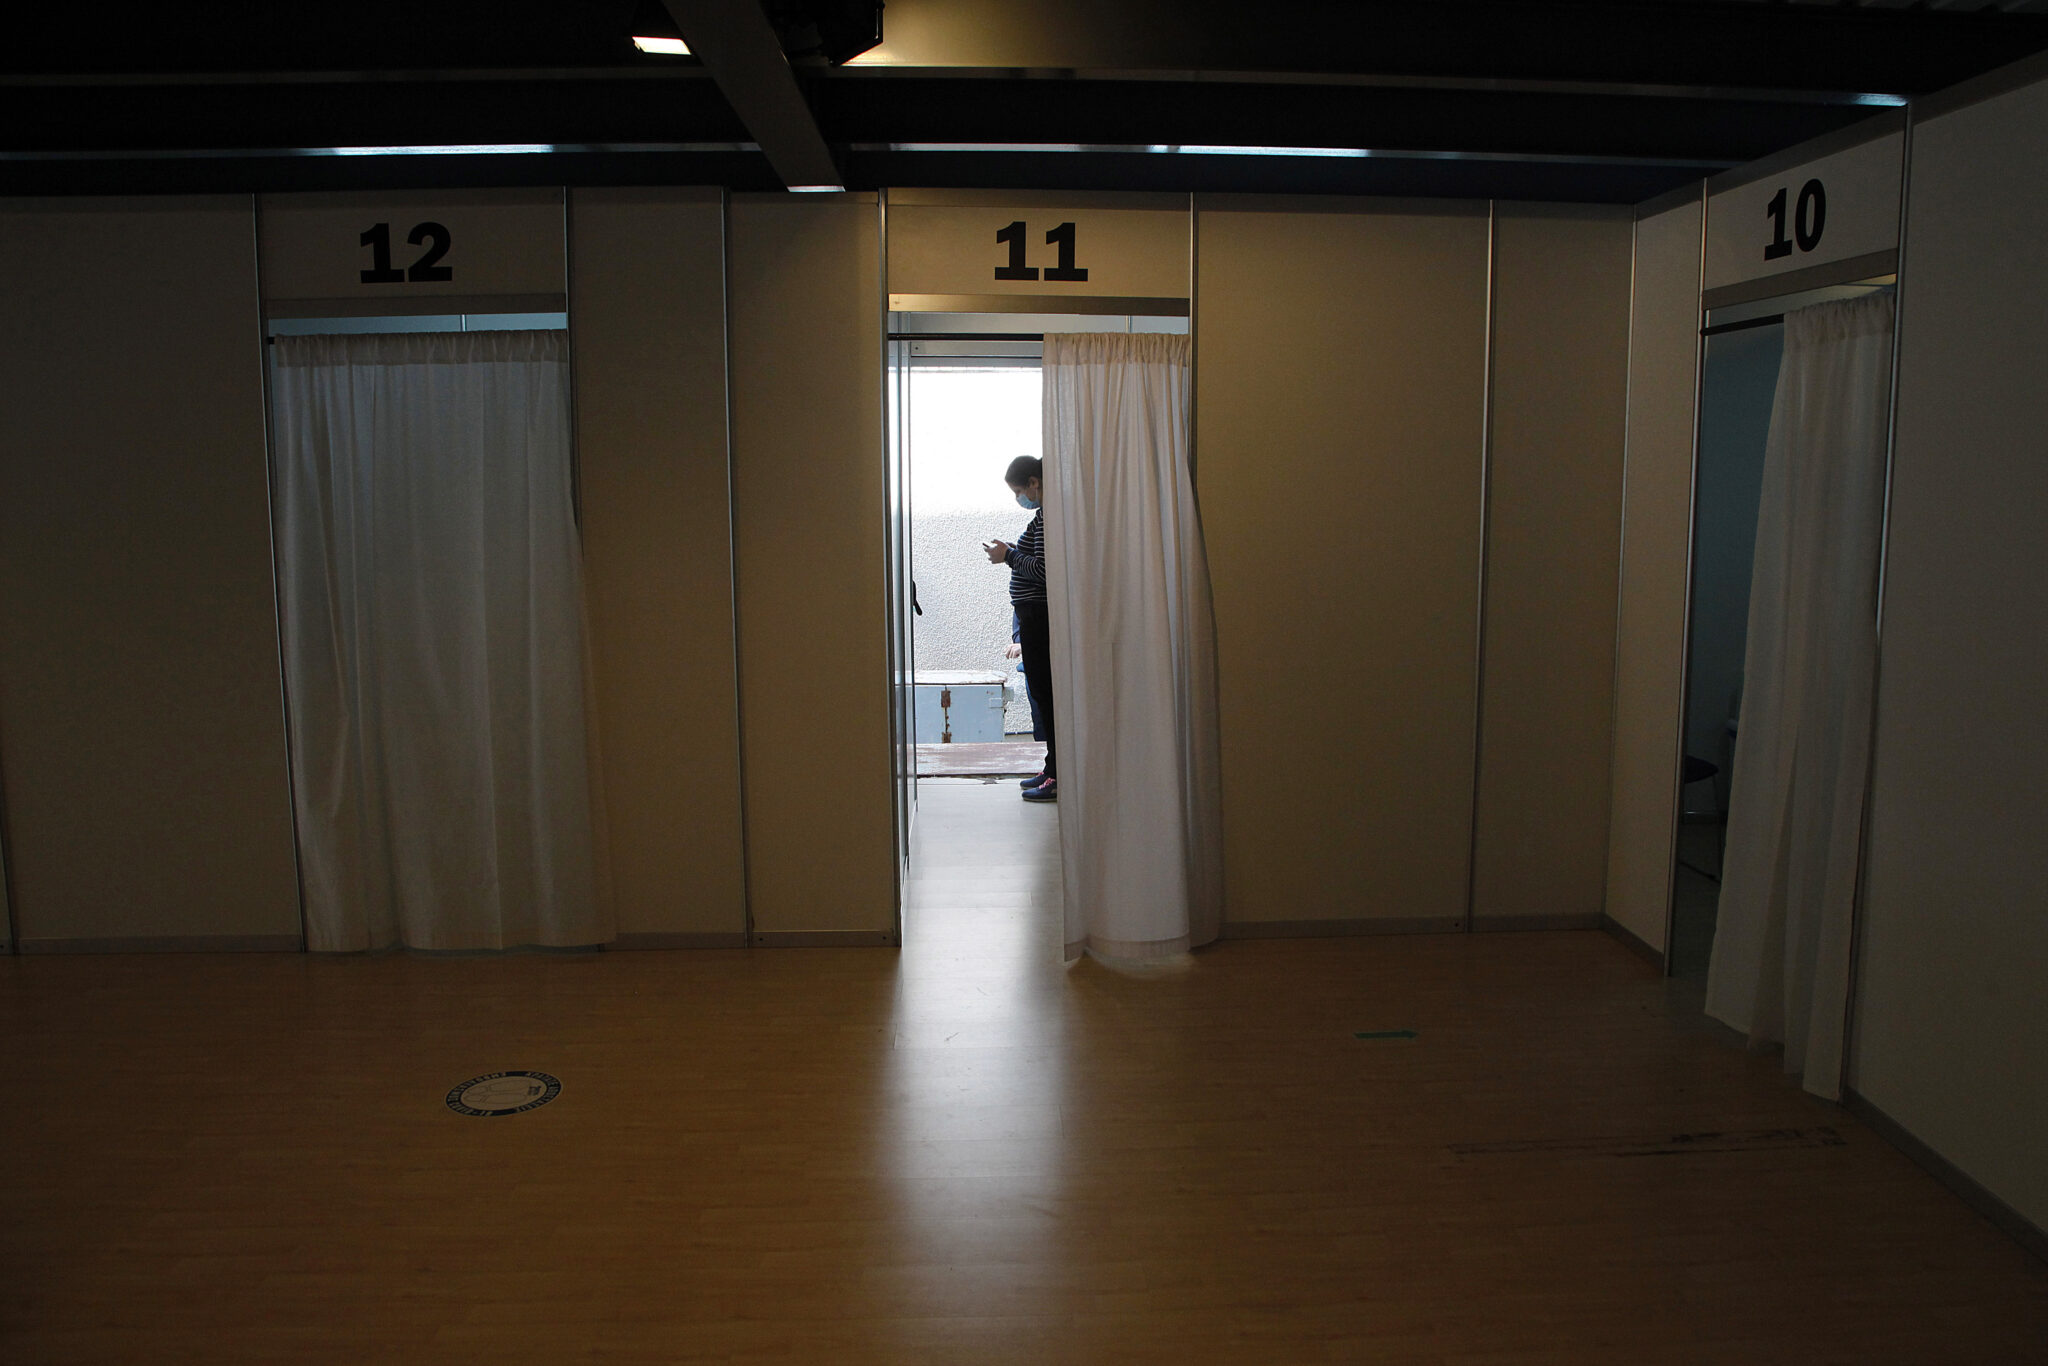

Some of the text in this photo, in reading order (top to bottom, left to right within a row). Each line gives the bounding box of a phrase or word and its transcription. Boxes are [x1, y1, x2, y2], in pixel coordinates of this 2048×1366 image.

[1764, 179, 1826, 260] 10
[360, 222, 453, 283] 12
[995, 221, 1088, 281] 11
